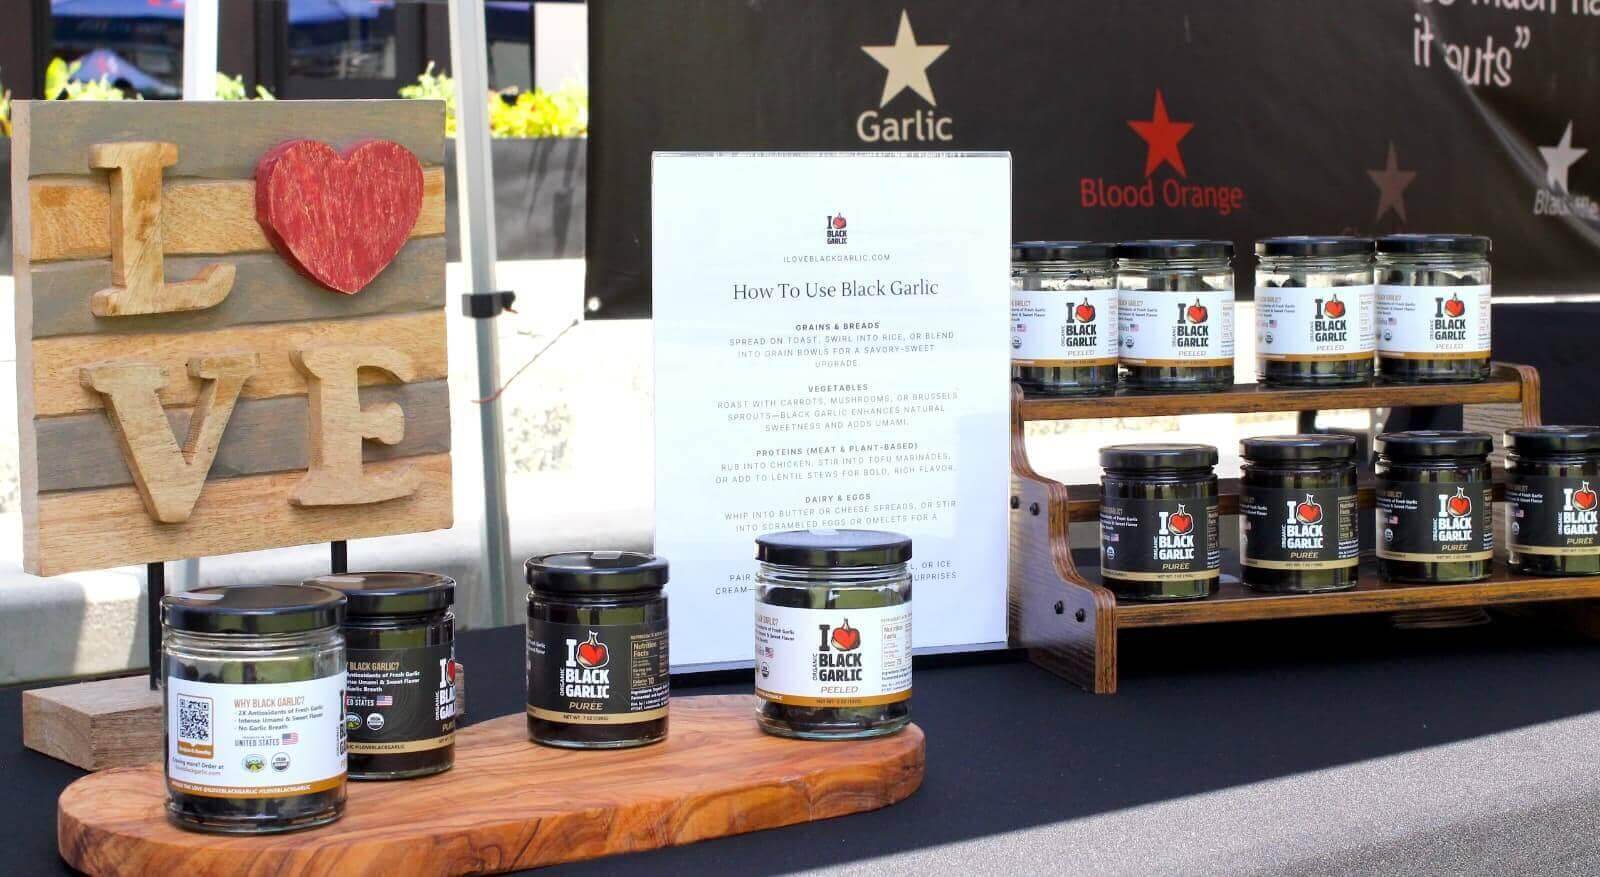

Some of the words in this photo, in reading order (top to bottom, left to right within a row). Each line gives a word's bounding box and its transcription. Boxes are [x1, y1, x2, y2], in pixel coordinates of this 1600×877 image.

[1414, 13, 1434, 67] it
[857, 111, 953, 142] Garlic
[1081, 178, 1153, 208] Blood
[1163, 180, 1243, 215] Orange
[91, 141, 236, 317] L
[827, 216, 832, 229] I
[784, 254, 890, 263] ILOVEBLACKGARLIC.COM
[734, 284, 773, 300] How
[778, 283, 800, 299] To
[806, 282, 836, 298] Use
[842, 280, 885, 296] Black
[890, 279, 938, 296] Garlic
[1066, 303, 1075, 323] I
[1177, 304, 1186, 324] I
[1315, 299, 1323, 319] I
[1435, 298, 1444, 317] I
[843, 322, 880, 330] BREADS
[1066, 325, 1096, 335] BLACK
[1177, 325, 1208, 336] BLACK
[1315, 320, 1346, 331] BLACK
[1435, 319, 1465, 329] BLACK
[730, 338, 766, 346] SPREAD
[770, 337, 783, 345] ON
[825, 335, 851, 343] SWIRL
[856, 334, 878, 342] INTO
[882, 332, 905, 341] RICE,
[910, 332, 921, 340] OR
[925, 331, 954, 339] BLEND
[1066, 337, 1096, 346] GARLIC
[1315, 332, 1347, 342] GARLIC
[1435, 331, 1465, 340] GARLIC
[1177, 338, 1208, 347] GARLIC
[738, 351, 760, 359] INTO
[765, 349, 793, 357] GRAIN
[797, 348, 829, 356] BOWLS
[833, 347, 850, 355] FOR
[864, 345, 935, 353] SAVORY-SWEET
[809, 384, 868, 393] VEGETABLES
[718, 400, 747, 408] ROAST
[753, 400, 775, 408] WITH
[781, 398, 826, 406] CARROTS,
[831, 395, 889, 405] MUSHROOMS,
[913, 392, 958, 401] BRUSSELS
[814, 408, 847, 417] GARLIC
[851, 406, 900, 415] ENHANCES
[904, 405, 944, 413] NATURAL
[766, 423, 821, 432] SWEETNESS
[848, 420, 871, 429] ADDS
[756, 448, 802, 457] PROTEINS
[807, 447, 836, 455] (MEAT
[849, 443, 918, 452] PLANT-BASED)
[721, 463, 739, 471] RUB
[744, 462, 766, 470] INTO
[770, 460, 814, 469] CHICKEN,
[818, 458, 839, 466] STIR
[869, 456, 892, 464] TOFU
[716, 476, 728, 484] OR
[732, 475, 750, 483] ADD
[756, 474, 767, 482] TO
[772, 472, 803, 481] LENTIL
[808, 471, 838, 479] STEWS
[864, 468, 889, 476] BOLD,
[894, 467, 915, 475] RICH
[806, 496, 833, 504] DAIRY
[847, 493, 871, 501] EGGS
[1563, 488, 1573, 511] I
[725, 512, 747, 520] WHIP
[753, 511, 774, 519] INTO
[779, 509, 814, 517] BUTTER
[819, 507, 830, 515] OR
[835, 505, 869, 514] CHEESE
[874, 503, 915, 512] SPREADS,
[921, 501, 932, 509] OR
[936, 500, 956, 508] STIR
[1287, 501, 1296, 524] I
[1439, 495, 1448, 517] I
[736, 524, 757, 532] INTO
[763, 520, 817, 530] SCRAMBLED
[822, 518, 845, 526] EGGS
[850, 517, 862, 525] OR
[866, 515, 907, 523] OMELETS
[1159, 512, 1169, 534] I
[1439, 518, 1472, 529] BLACK
[1564, 511, 1597, 523] BLACK
[1287, 524, 1323, 536] BLACK
[1439, 530, 1472, 541] GARLIC
[1564, 524, 1598, 535] GARLIC
[1159, 535, 1194, 548] BLACK
[1287, 538, 1323, 548] GARLIC
[1159, 548, 1194, 560] GARLIC
[1291, 550, 1318, 558] PURÉE
[937, 560, 951, 568] ICE
[913, 572, 956, 582] URPRISES
[819, 625, 830, 651] I
[566, 639, 577, 667] I
[350, 662, 371, 671] BLACK
[372, 662, 399, 670] GARLIC?
[819, 653, 862, 667] BLACK
[440, 658, 446, 688] I
[566, 669, 609, 683] BLACK
[819, 669, 862, 681] GARLIC
[566, 685, 609, 698] GARLIC
[234, 699, 250, 708] WHY
[253, 698, 276, 707] BLACK
[278, 696, 304, 706] GARLIC?
